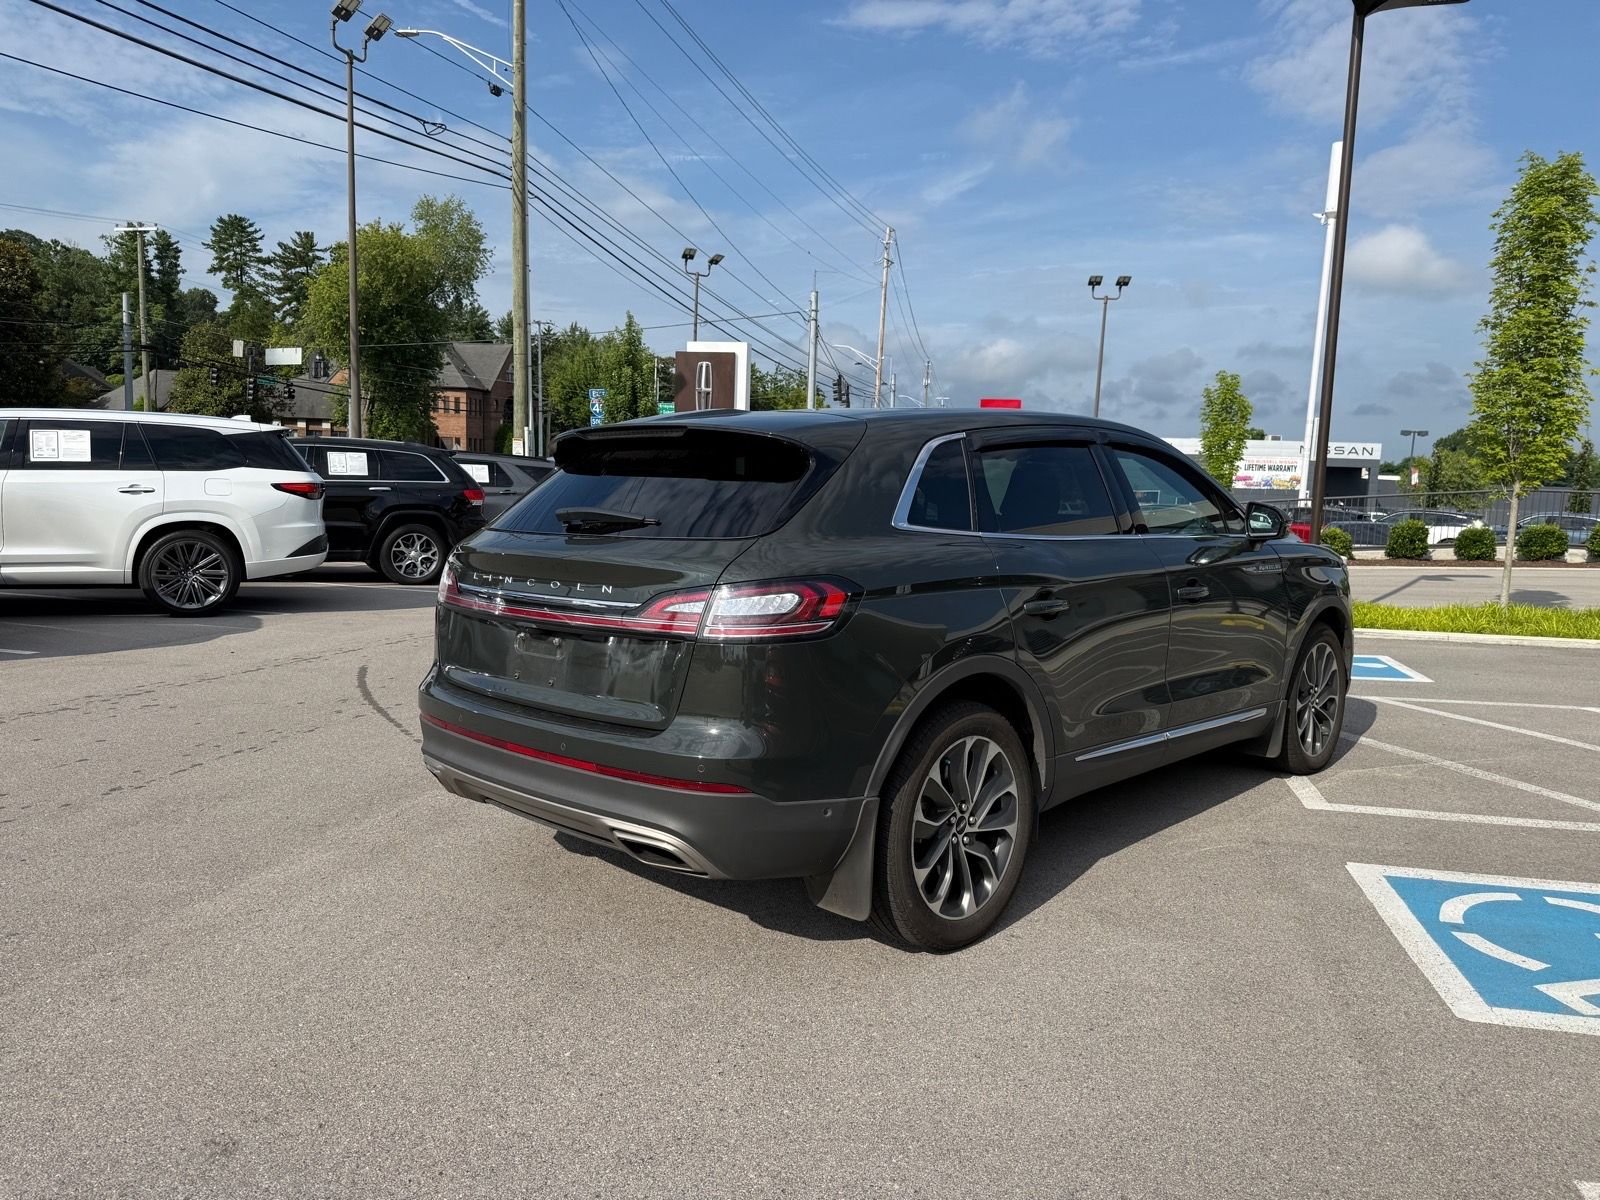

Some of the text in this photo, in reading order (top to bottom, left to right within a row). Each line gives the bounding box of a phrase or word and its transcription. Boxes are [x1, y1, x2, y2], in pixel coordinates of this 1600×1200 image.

[1244, 463, 1298, 472] LIFETIME WARRANTY
[473, 571, 613, 594] LINCOLN
